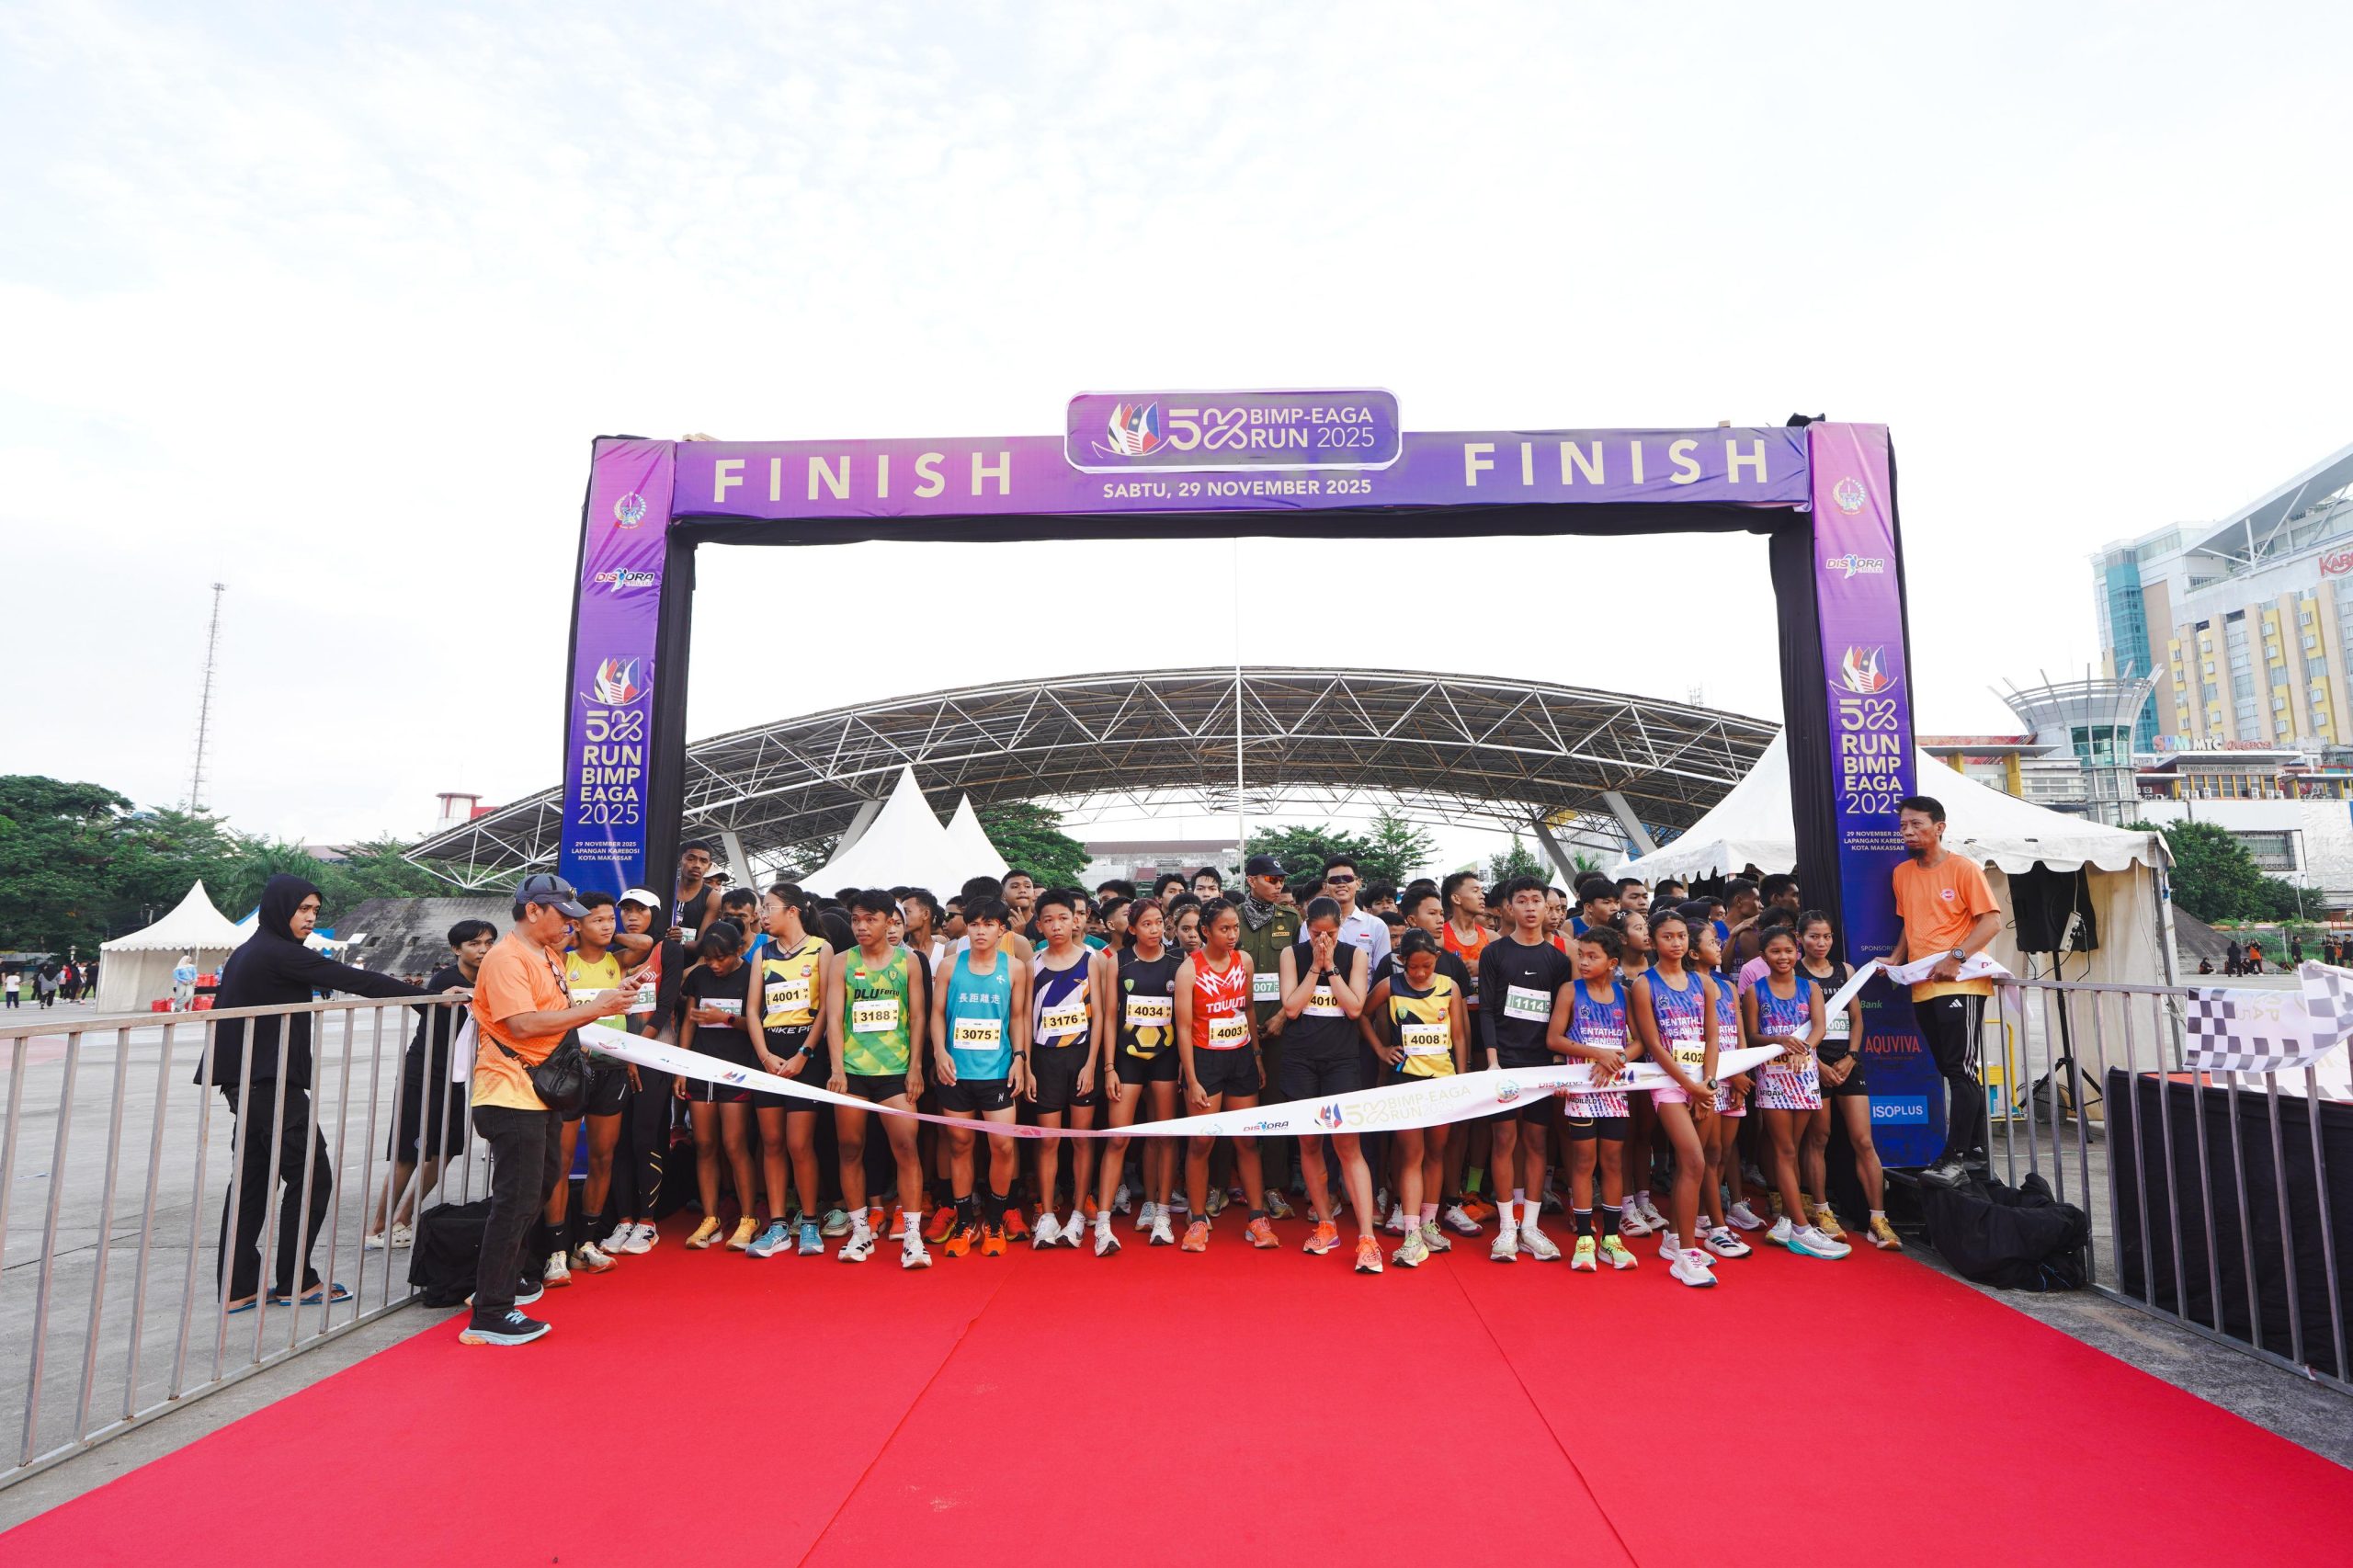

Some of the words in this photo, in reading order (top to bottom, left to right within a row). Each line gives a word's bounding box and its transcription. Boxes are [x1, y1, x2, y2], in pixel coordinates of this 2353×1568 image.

[1251, 407, 1373, 425] BIMP-EAGA
[1251, 427, 1308, 449] RUN
[1317, 426, 1375, 449] 2025
[1464, 439, 1768, 486] FINISH
[713, 451, 1010, 503] FINISH
[1103, 483, 1172, 499] SABTU,
[1178, 482, 1200, 497] 29
[1207, 480, 1320, 497] NOVEMBER
[1325, 479, 1371, 494] 2025
[1841, 734, 1901, 755] RUN
[2193, 738, 2222, 751] MTC
[583, 745, 642, 766] RUN
[1844, 756, 1902, 774] BIMP
[581, 767, 641, 785] BIMP
[1845, 776, 1903, 791] EAGA
[580, 786, 639, 802] EAGA
[1846, 793, 1904, 813] 2025
[578, 803, 640, 824] 2025
[773, 990, 800, 1002] 4001
[854, 988, 880, 999] DLU
[959, 993, 1000, 1005] 長距離走
[1310, 995, 1337, 1006] 4010
[1134, 1006, 1164, 1017] 4034
[1515, 998, 1544, 1011] 1114
[1860, 1000, 1882, 1008] Bank
[860, 1011, 891, 1022] 3188
[1050, 1015, 1078, 1027] 3176
[767, 1027, 797, 1035] NIKE
[962, 1029, 992, 1040] 3075
[1218, 1026, 1243, 1039] 4003
[1411, 1035, 1440, 1045] 4008
[1865, 1035, 1920, 1054] AQUVIVA
[1388, 1085, 1471, 1109] BIMP-EAGA
[1391, 1106, 1423, 1121] RUN
[1873, 1106, 1923, 1119] ISOPLUS
